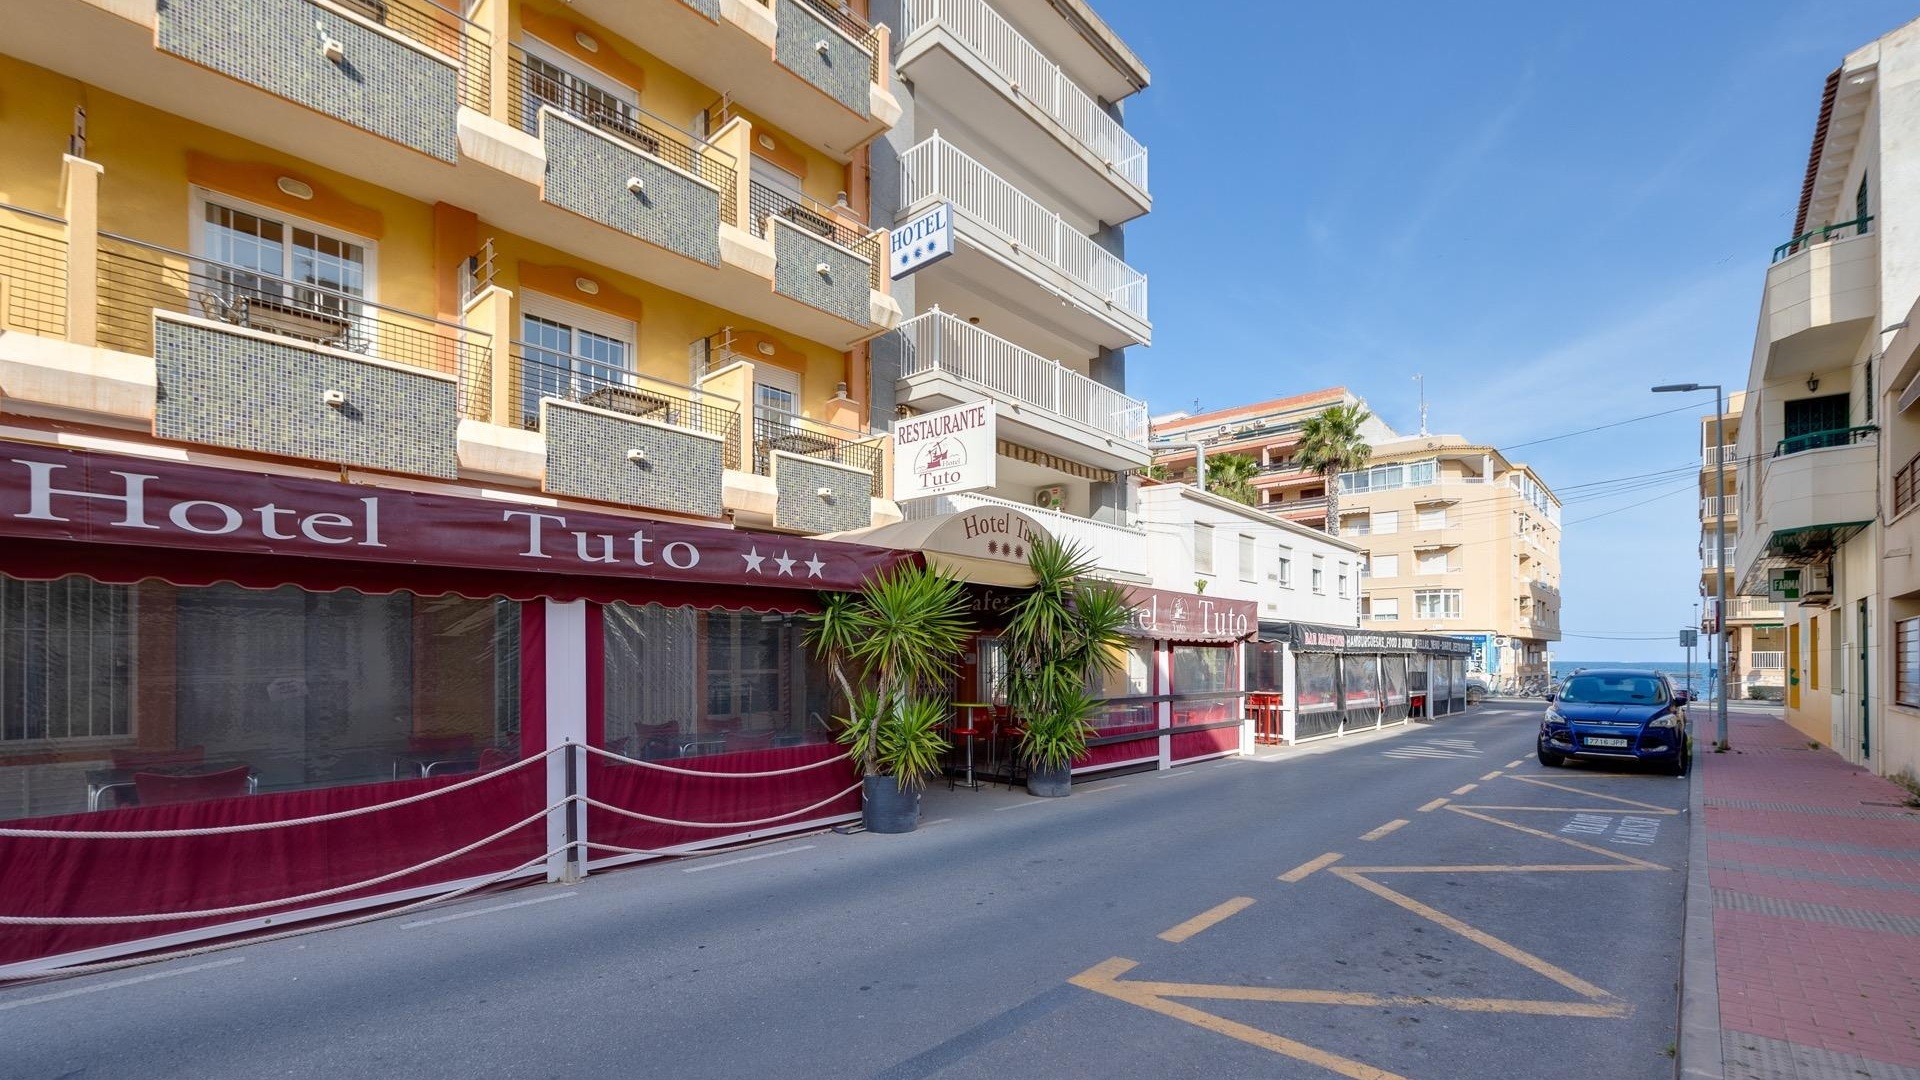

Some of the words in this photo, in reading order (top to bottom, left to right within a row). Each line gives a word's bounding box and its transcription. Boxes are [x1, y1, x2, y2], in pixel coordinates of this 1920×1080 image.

[891, 211, 946, 254] HOTEL
[898, 406, 986, 445] RESTAURANTE
[919, 471, 961, 488] Tuto
[942, 457, 961, 467] Hotel
[11, 459, 388, 548] Hotel
[503, 510, 701, 570] Tuto
[962, 512, 1010, 540] Hotel
[1198, 600, 1248, 636] Tuto
